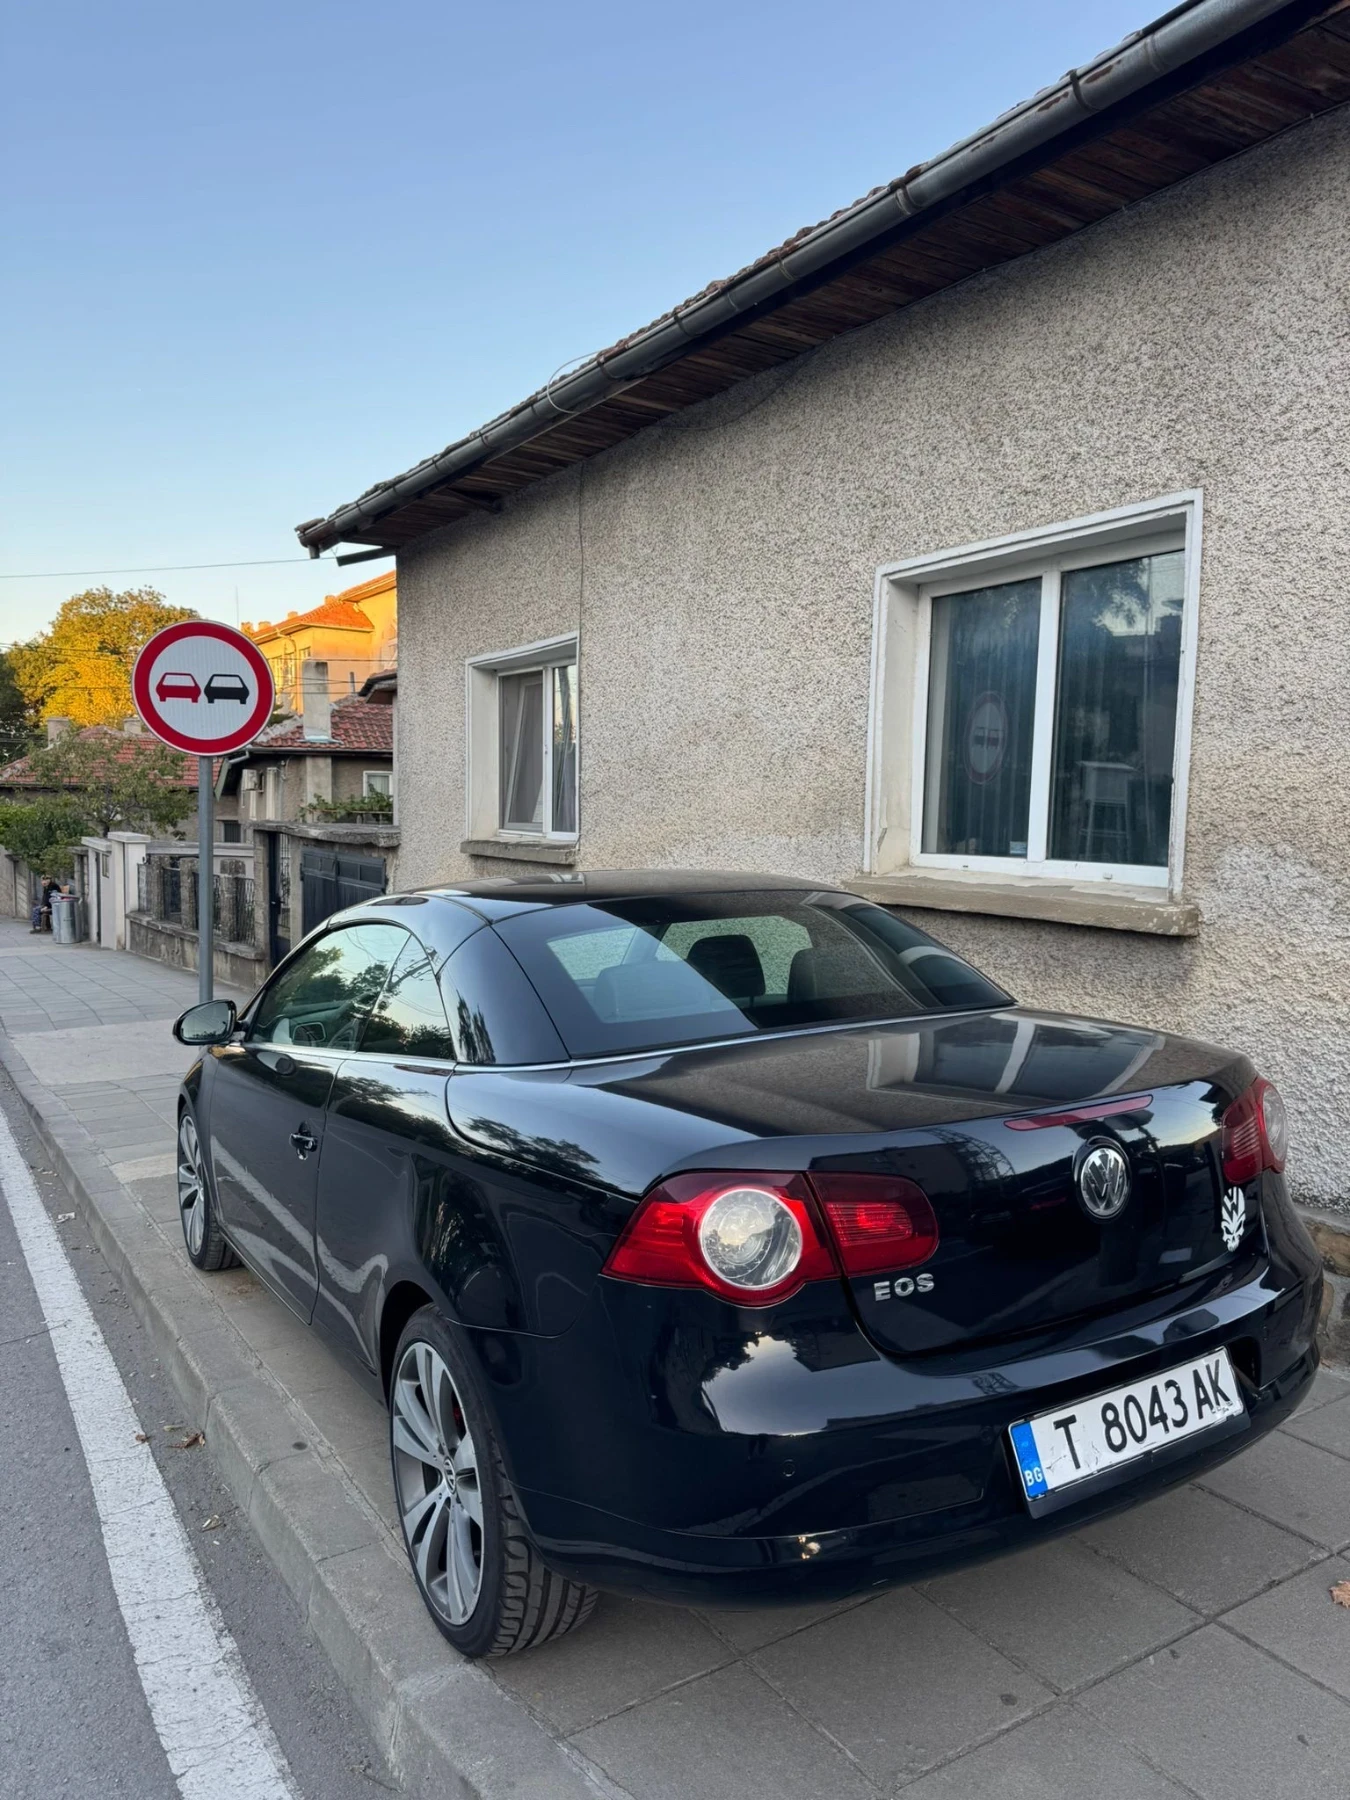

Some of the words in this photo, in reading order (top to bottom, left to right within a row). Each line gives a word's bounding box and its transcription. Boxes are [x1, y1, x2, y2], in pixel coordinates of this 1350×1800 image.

[874, 1273, 935, 1302] EOS
[1053, 1414, 1081, 1470] T
[1101, 1379, 1189, 1453] 8043
[1192, 1359, 1234, 1420] AK
[1024, 1468, 1043, 1487] BG
